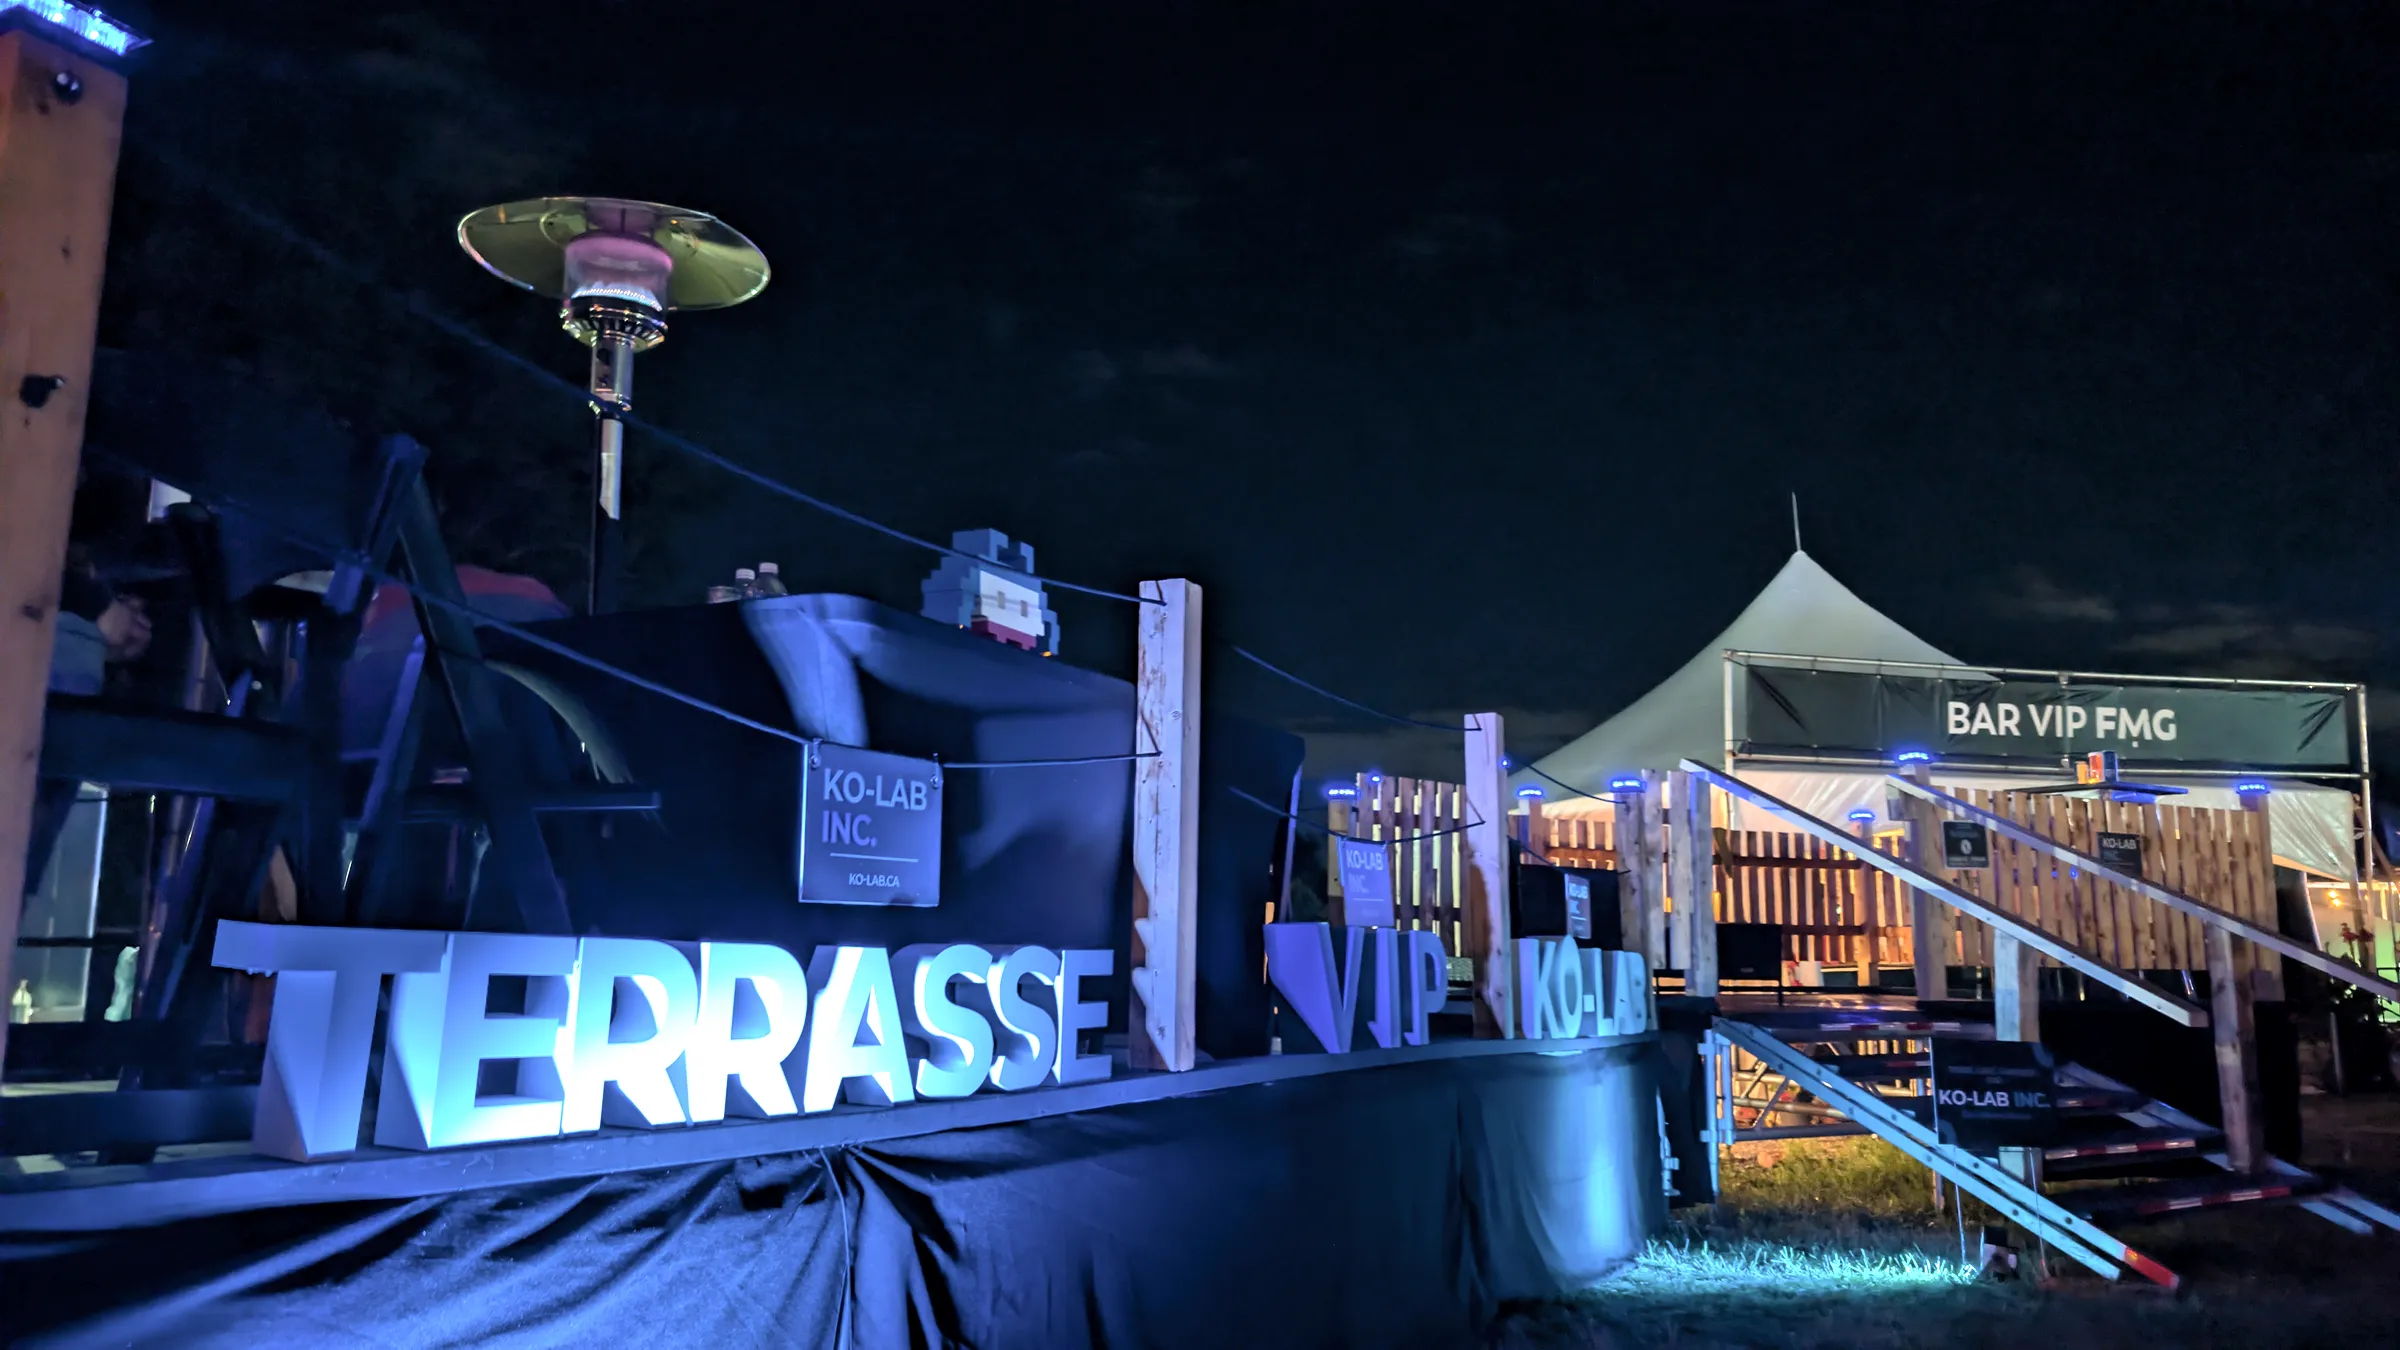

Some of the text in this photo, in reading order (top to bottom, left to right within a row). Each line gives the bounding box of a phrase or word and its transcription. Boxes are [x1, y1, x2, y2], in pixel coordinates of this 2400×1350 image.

[1947, 701, 2177, 741] BAR VIP FMG
[823, 768, 928, 811] KO-LAB
[822, 810, 877, 847] INC.
[2103, 837, 2137, 849] KO-LAB
[1346, 849, 1384, 871] KO-LAB
[849, 873, 900, 888] KO-LAB.CA
[211, 918, 1648, 1162] TERRASSE VIP KO-LAB
[1938, 1089, 2009, 1107] KO-LAB
